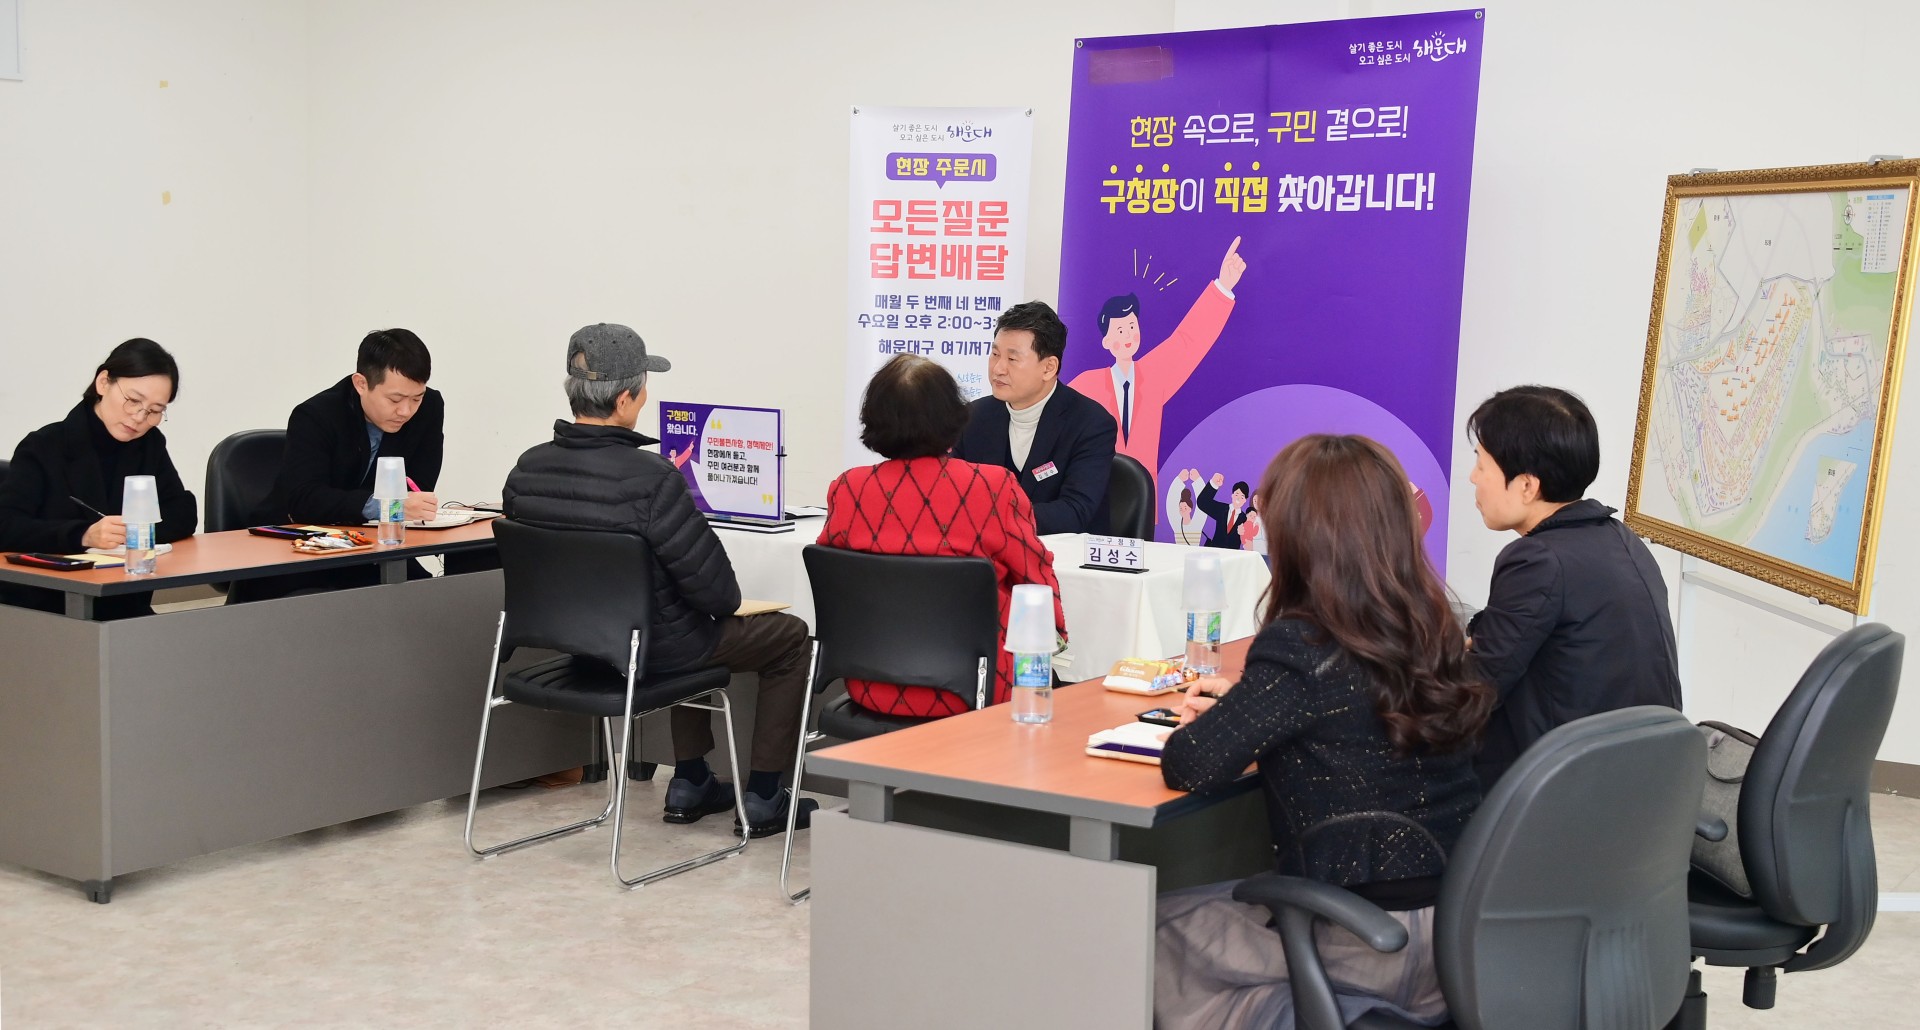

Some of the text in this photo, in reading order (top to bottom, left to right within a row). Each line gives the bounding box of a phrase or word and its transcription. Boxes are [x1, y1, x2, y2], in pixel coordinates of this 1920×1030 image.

[1348, 40, 1403, 54] 살기 좋은 도시
[1359, 52, 1411, 66] 오고 싶은 도시
[893, 124, 938, 132] 살기 좋은 도시
[1130, 106, 1409, 148] 현장 속으로, 구민 곁으로!
[915, 134, 929, 142] 싶은
[931, 134, 945, 142] 도시
[896, 157, 987, 177] 현장 주문시
[1100, 172, 1435, 215] 구청장이 직접 찾아갑니다!
[870, 200, 1010, 237] 모든질문
[869, 244, 1009, 281] 답변배달
[875, 295, 1002, 311] 매월 두 번째 네 번째
[857, 313, 899, 329] 수요일
[904, 314, 933, 330] 오후
[878, 339, 935, 355] 해운대구
[666, 410, 697, 422] 구청장이
[666, 423, 698, 436] 왔습니다.
[707, 449, 731, 459] 현장에서
[707, 461, 760, 473] 주민 여러분과 함께
